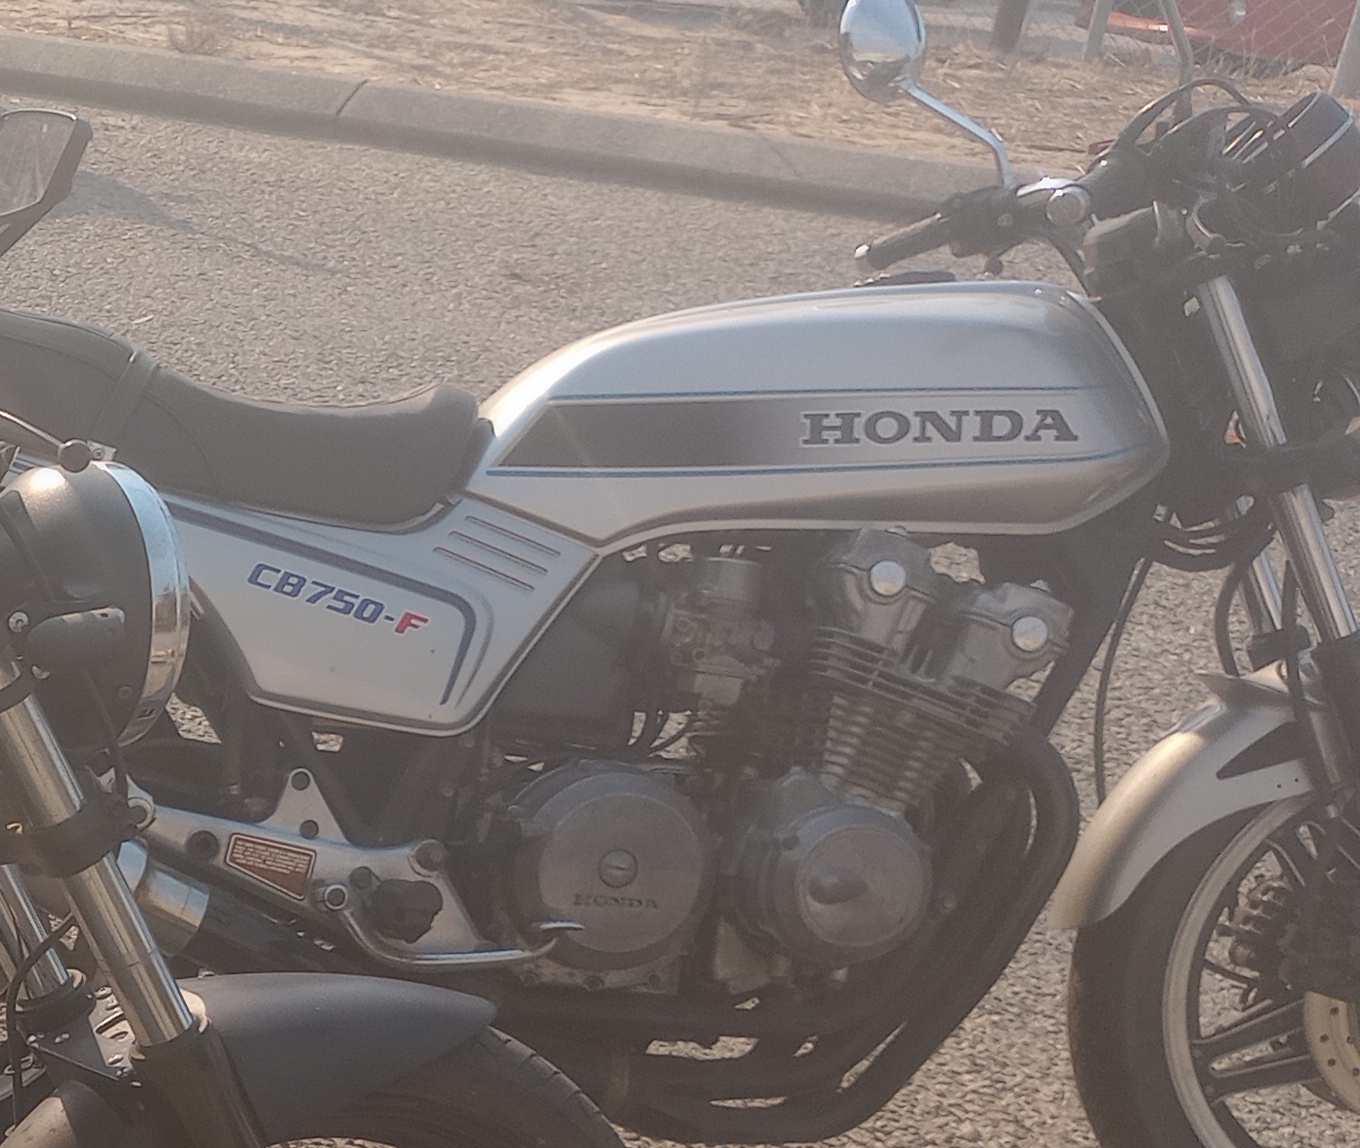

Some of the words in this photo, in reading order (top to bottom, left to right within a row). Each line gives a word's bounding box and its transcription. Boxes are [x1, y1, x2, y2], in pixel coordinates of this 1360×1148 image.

[801, 409, 1079, 445] HONDA
[247, 563, 429, 634] CB750-F
[573, 893, 658, 909] HONDA
